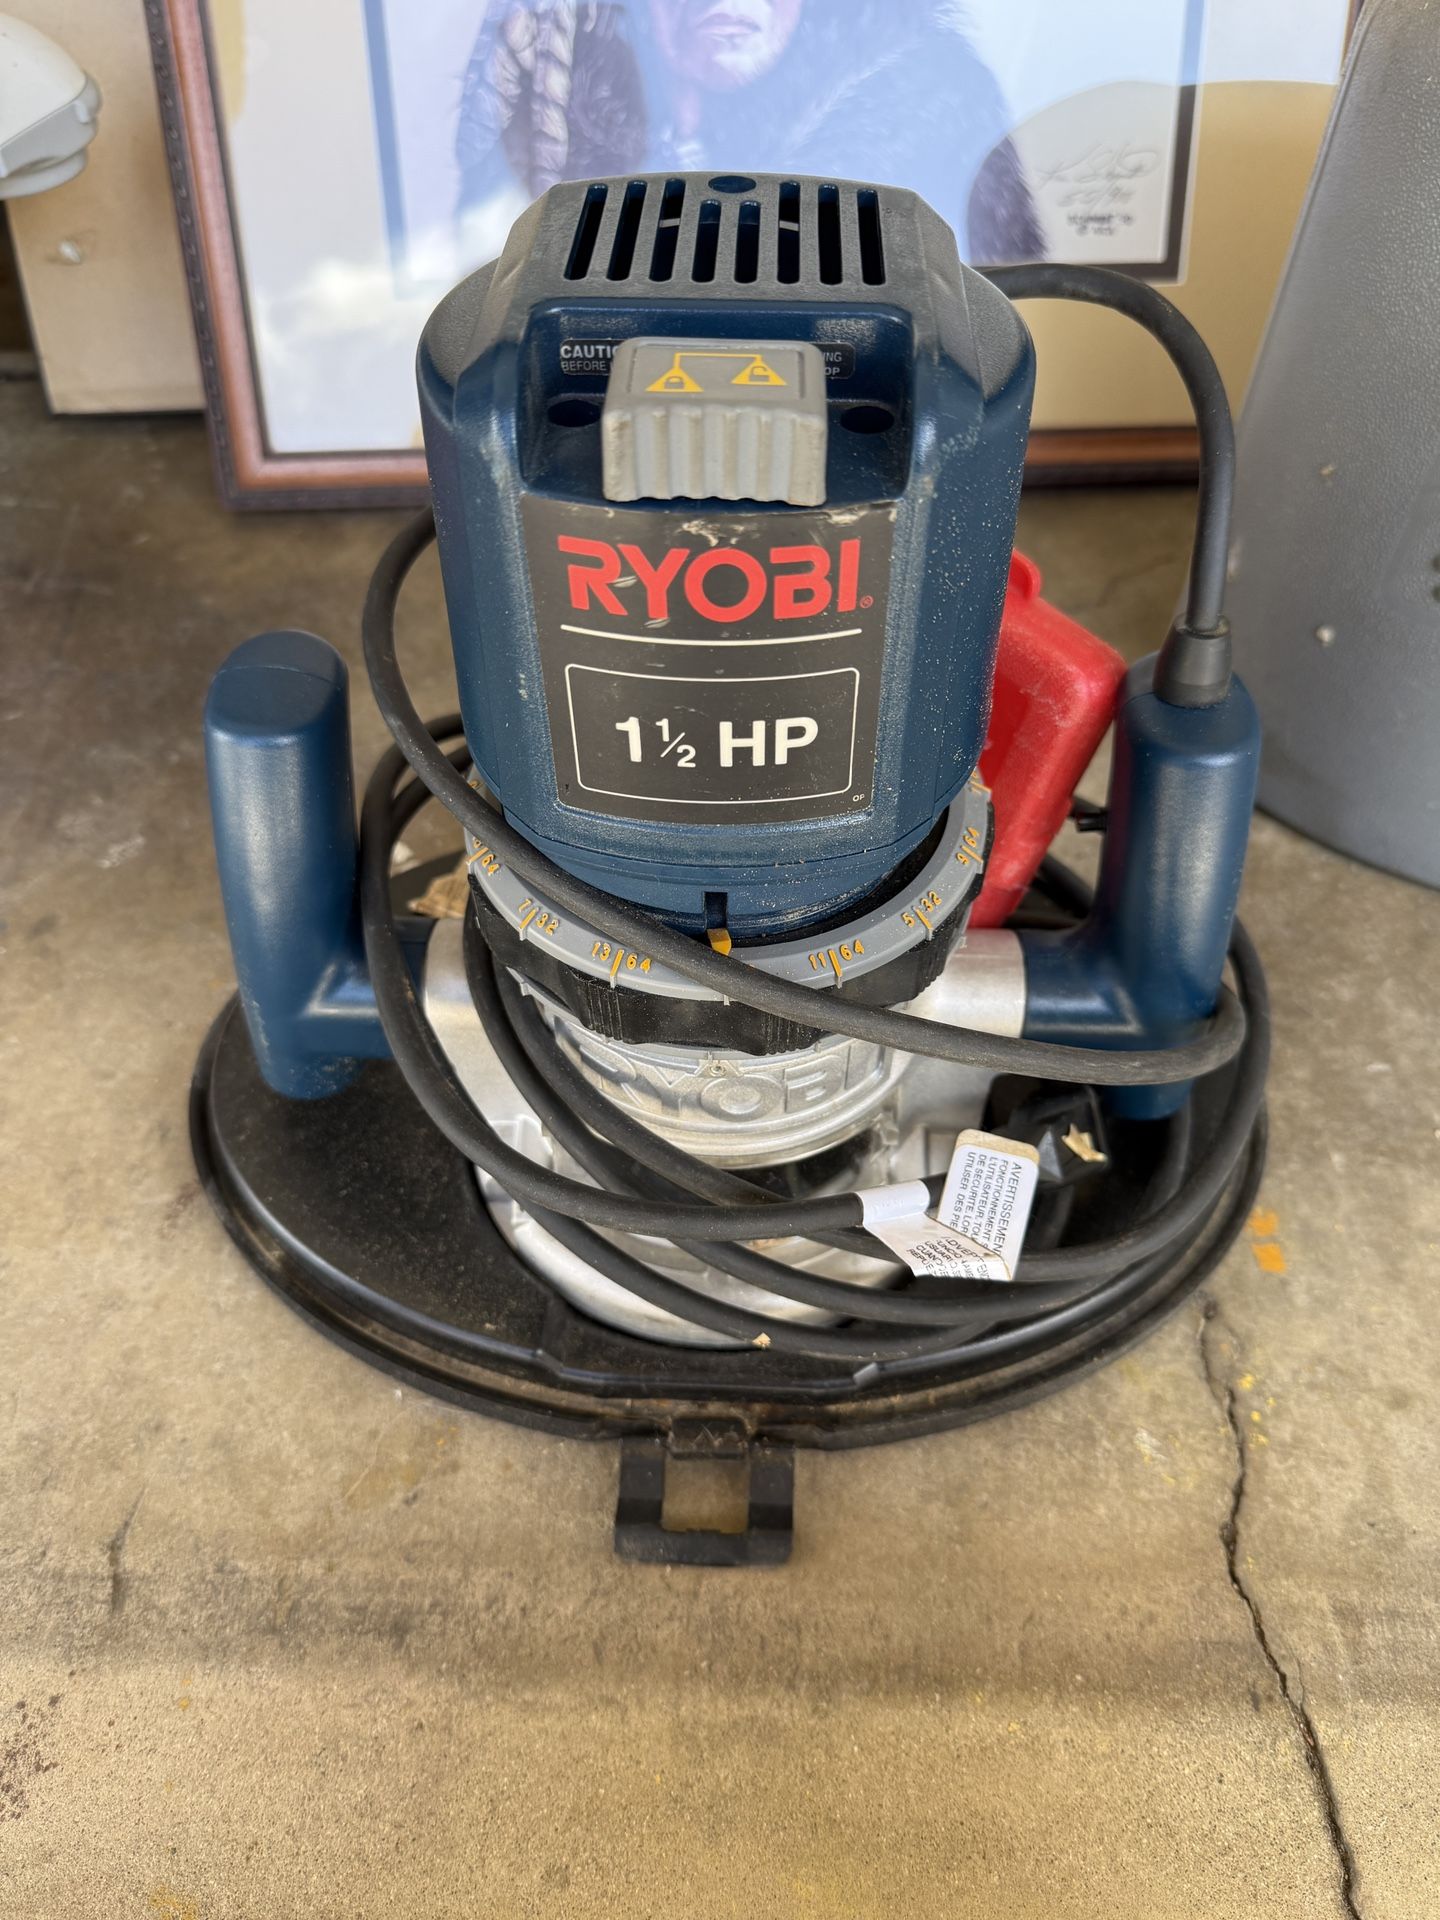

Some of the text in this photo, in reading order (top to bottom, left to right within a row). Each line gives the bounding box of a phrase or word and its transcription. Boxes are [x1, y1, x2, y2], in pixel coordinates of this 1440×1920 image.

[561, 361, 607, 372] BEFORE
[557, 534, 861, 623] RYOBI
[719, 716, 819, 768] HP
[959, 1151, 977, 1190] UTILISER
[976, 1154, 988, 1168] DE
[954, 1193, 966, 1212] DES
[981, 1159, 1009, 1241] FONCTIONNEMENT
